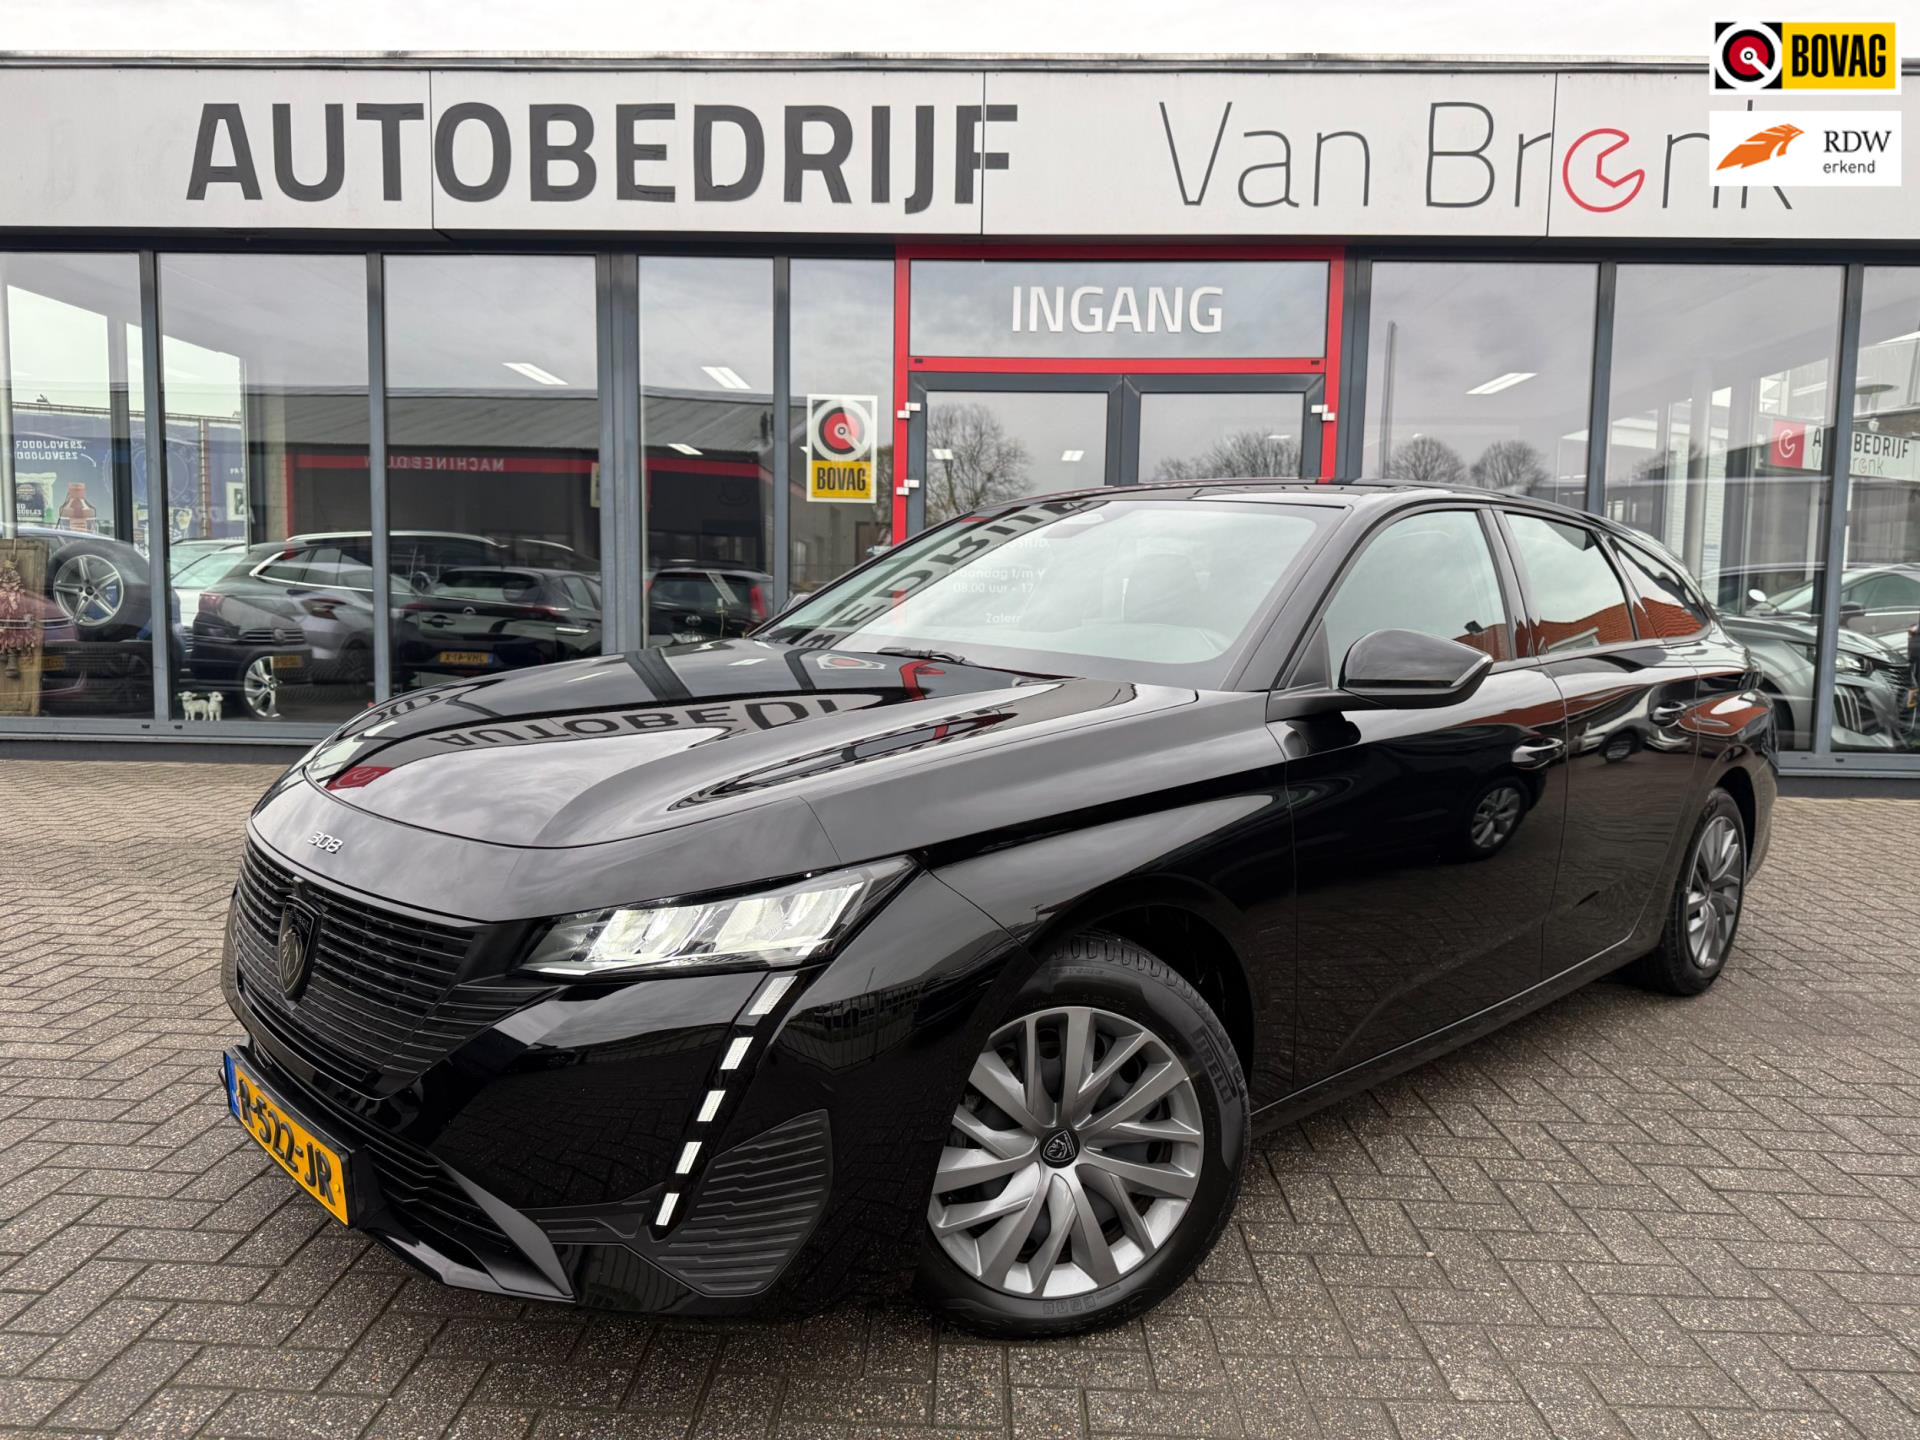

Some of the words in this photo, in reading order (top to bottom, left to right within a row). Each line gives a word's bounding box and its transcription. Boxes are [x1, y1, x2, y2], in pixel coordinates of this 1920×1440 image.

[186, 101, 1018, 215] AUTOBEDRIJF
[1159, 101, 1369, 208] Van
[1012, 286, 1224, 333] INGANG
[1812, 427, 1910, 460] ABEDRIJF
[816, 466, 867, 492] BOVAG
[307, 830, 343, 854] 308
[238, 1078, 336, 1206] R-522-JR
